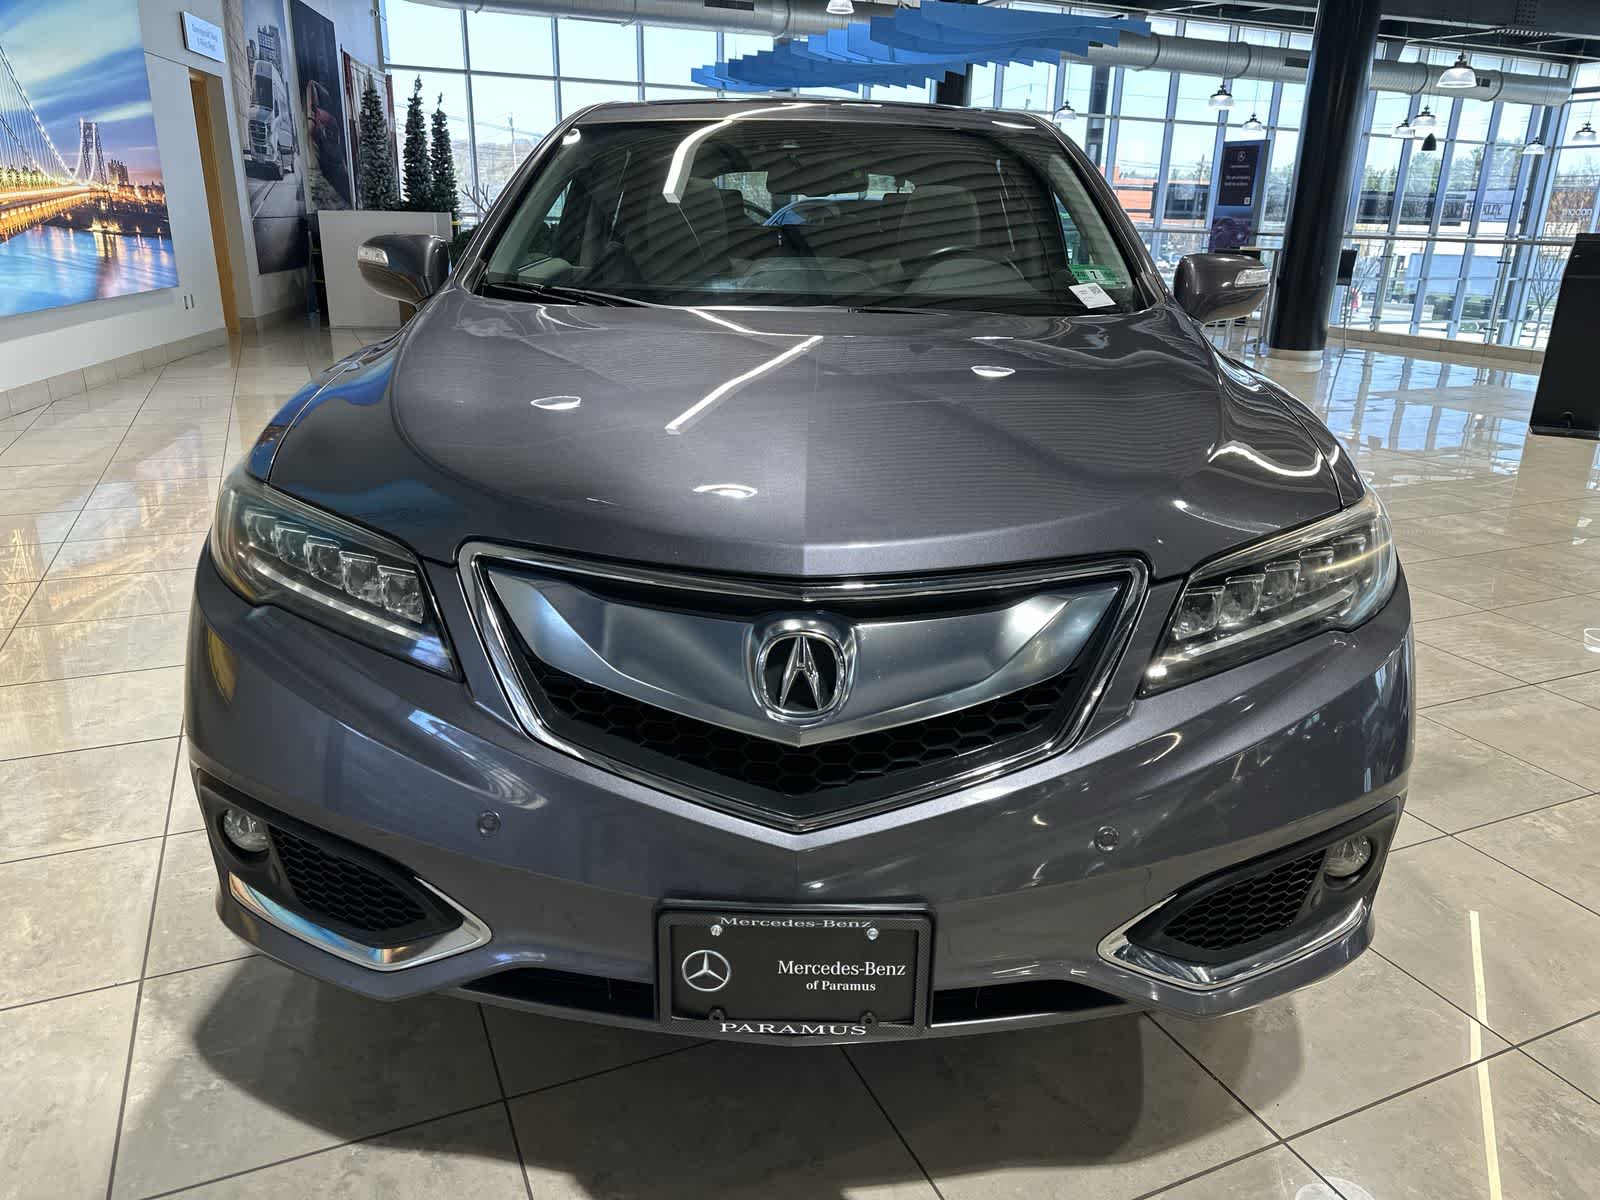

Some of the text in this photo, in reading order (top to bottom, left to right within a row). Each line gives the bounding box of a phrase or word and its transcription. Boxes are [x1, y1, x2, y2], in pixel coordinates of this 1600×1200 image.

[720, 916, 873, 928] Mercedes-Benz
[777, 960, 907, 976] Mercedes-Benz
[806, 980, 876, 991] of Paramus
[720, 1023, 867, 1035] PARAMUS
